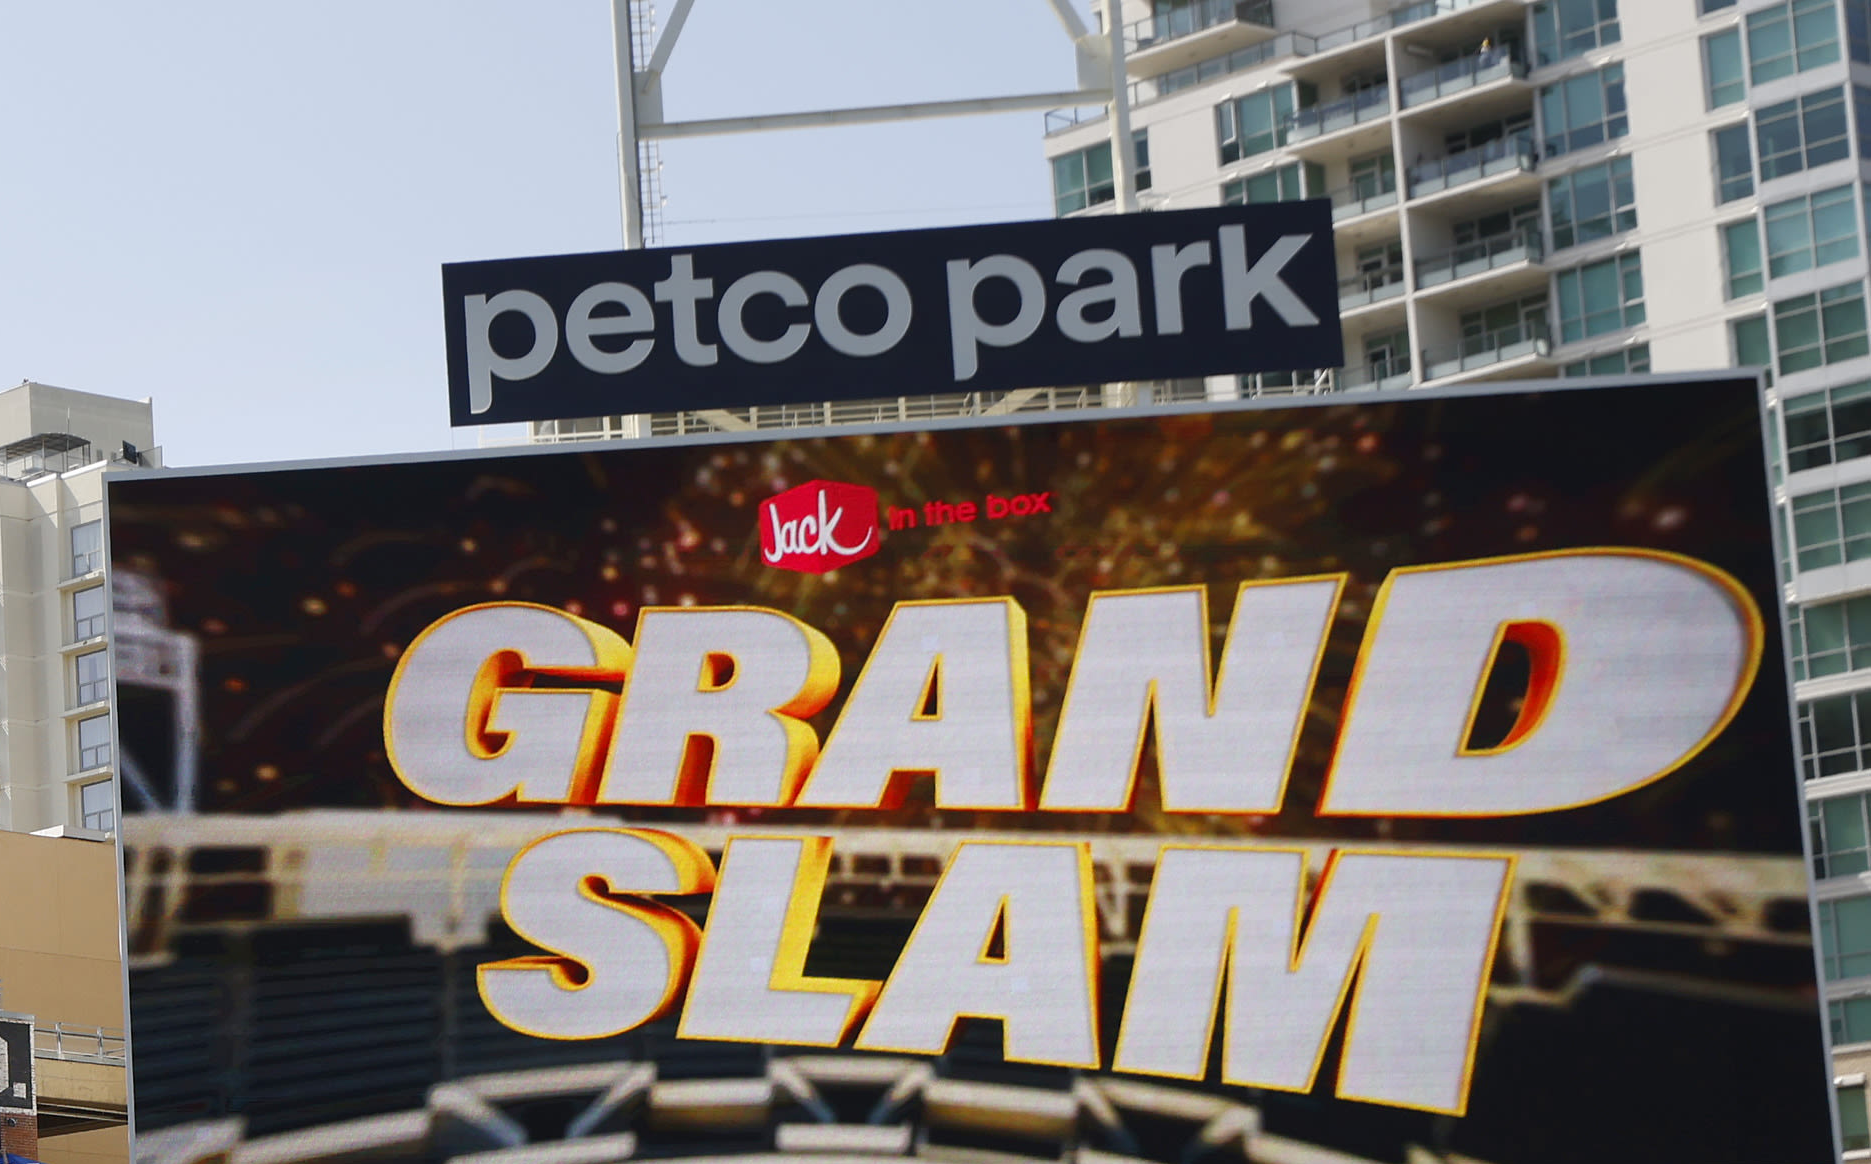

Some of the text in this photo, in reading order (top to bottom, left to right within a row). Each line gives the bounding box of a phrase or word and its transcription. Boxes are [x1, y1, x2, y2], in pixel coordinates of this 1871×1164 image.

[461, 221, 1324, 415] petco park
[764, 489, 1052, 563] Jack in the box
[382, 545, 1766, 819] GRAND
[475, 824, 1522, 1118] SLAM
